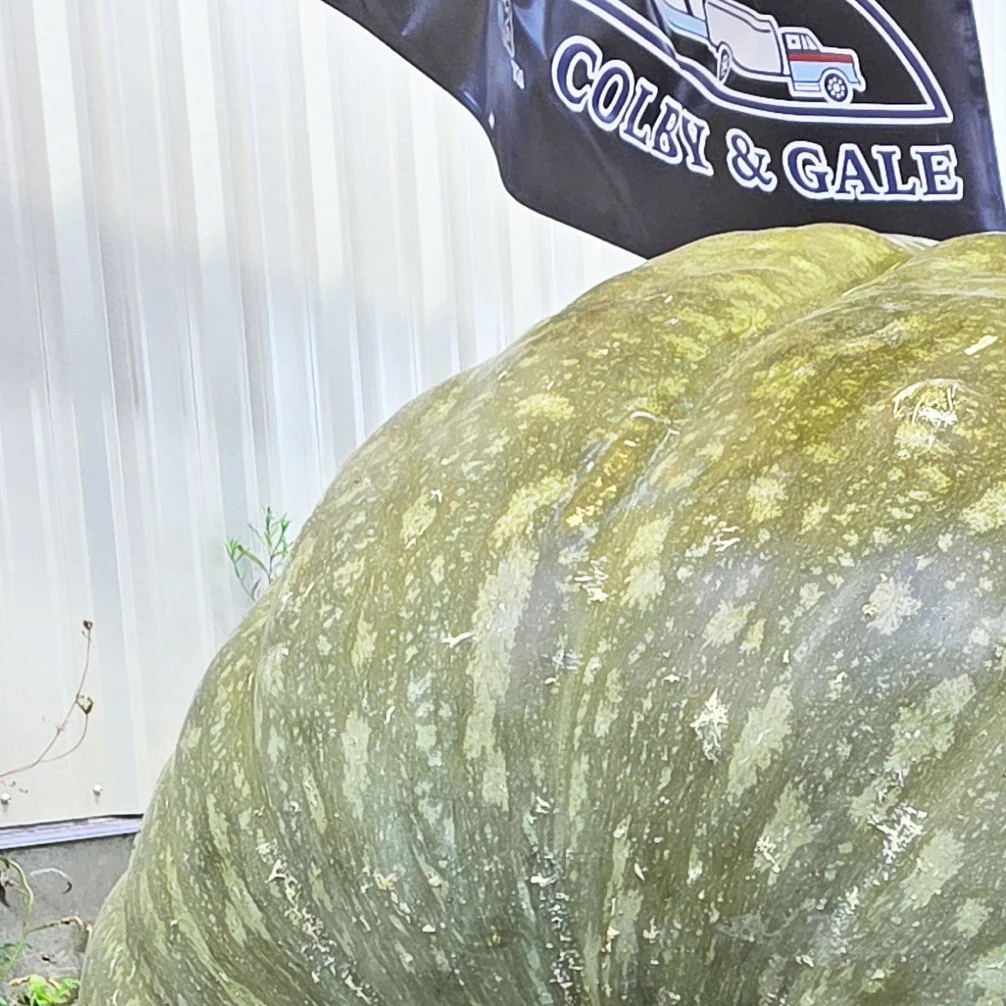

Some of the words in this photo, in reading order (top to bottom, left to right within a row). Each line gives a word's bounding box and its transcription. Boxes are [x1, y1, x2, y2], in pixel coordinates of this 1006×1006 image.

[552, 35, 714, 176] COLBY
[726, 128, 778, 192] &
[782, 141, 963, 200] GALE
